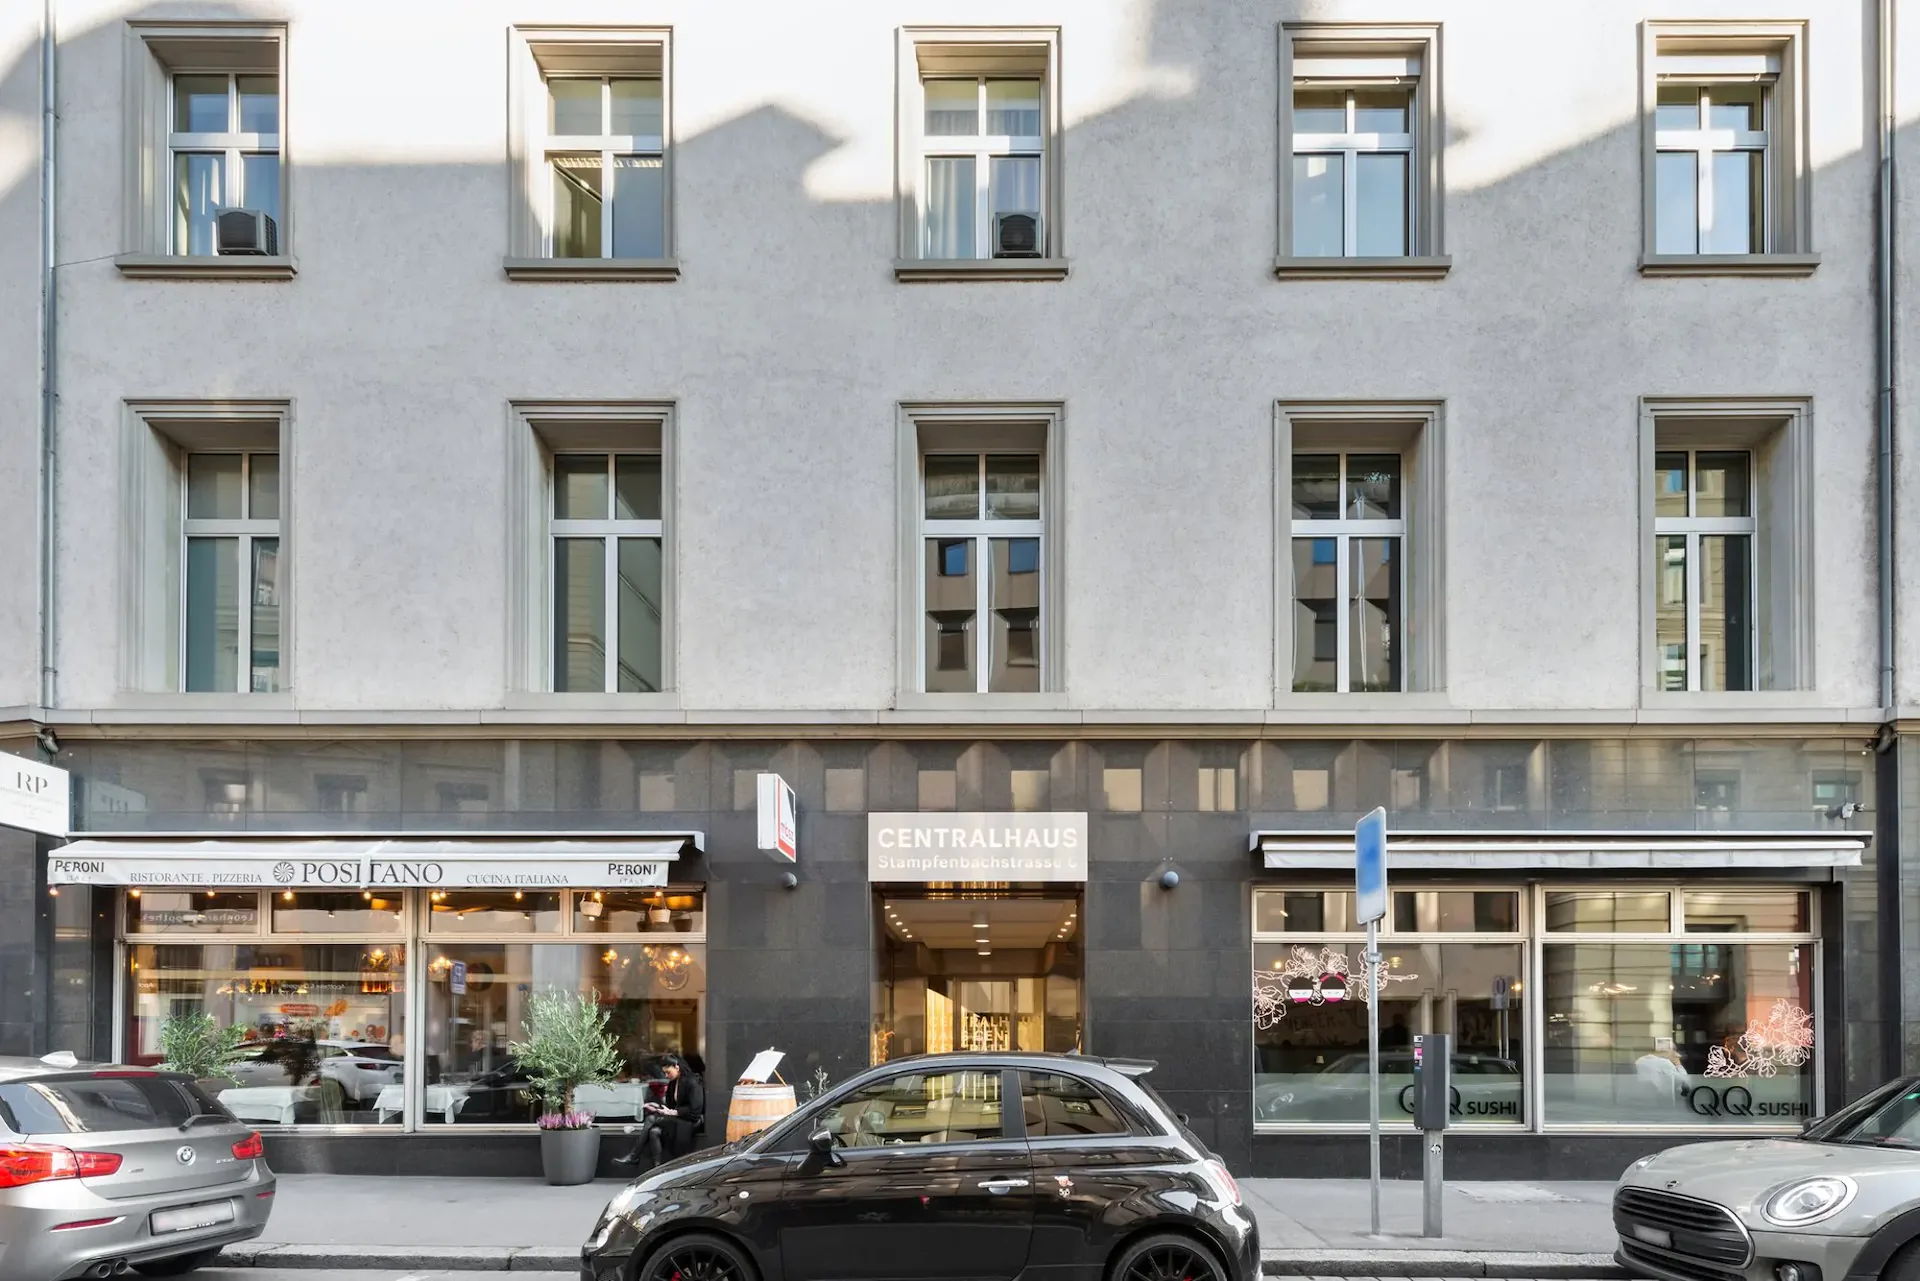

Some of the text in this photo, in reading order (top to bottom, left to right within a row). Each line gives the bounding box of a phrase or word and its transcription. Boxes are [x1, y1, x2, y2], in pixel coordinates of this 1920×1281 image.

[17, 771, 48, 794] RP
[878, 827, 1078, 849] CENTRALHAUS
[54, 860, 105, 873] PERONI
[607, 863, 657, 875] PERONI
[878, 855, 1062, 871] Stampfenbachstrasse
[130, 872, 263, 883] RISTORANTE PIZZERIA
[301, 863, 443, 884] POSITANO
[466, 874, 569, 885] CUCINA ITALIANA
[1466, 1101, 1517, 1116] SUSHI
[1689, 1085, 1809, 1117] QQ SUSHI
